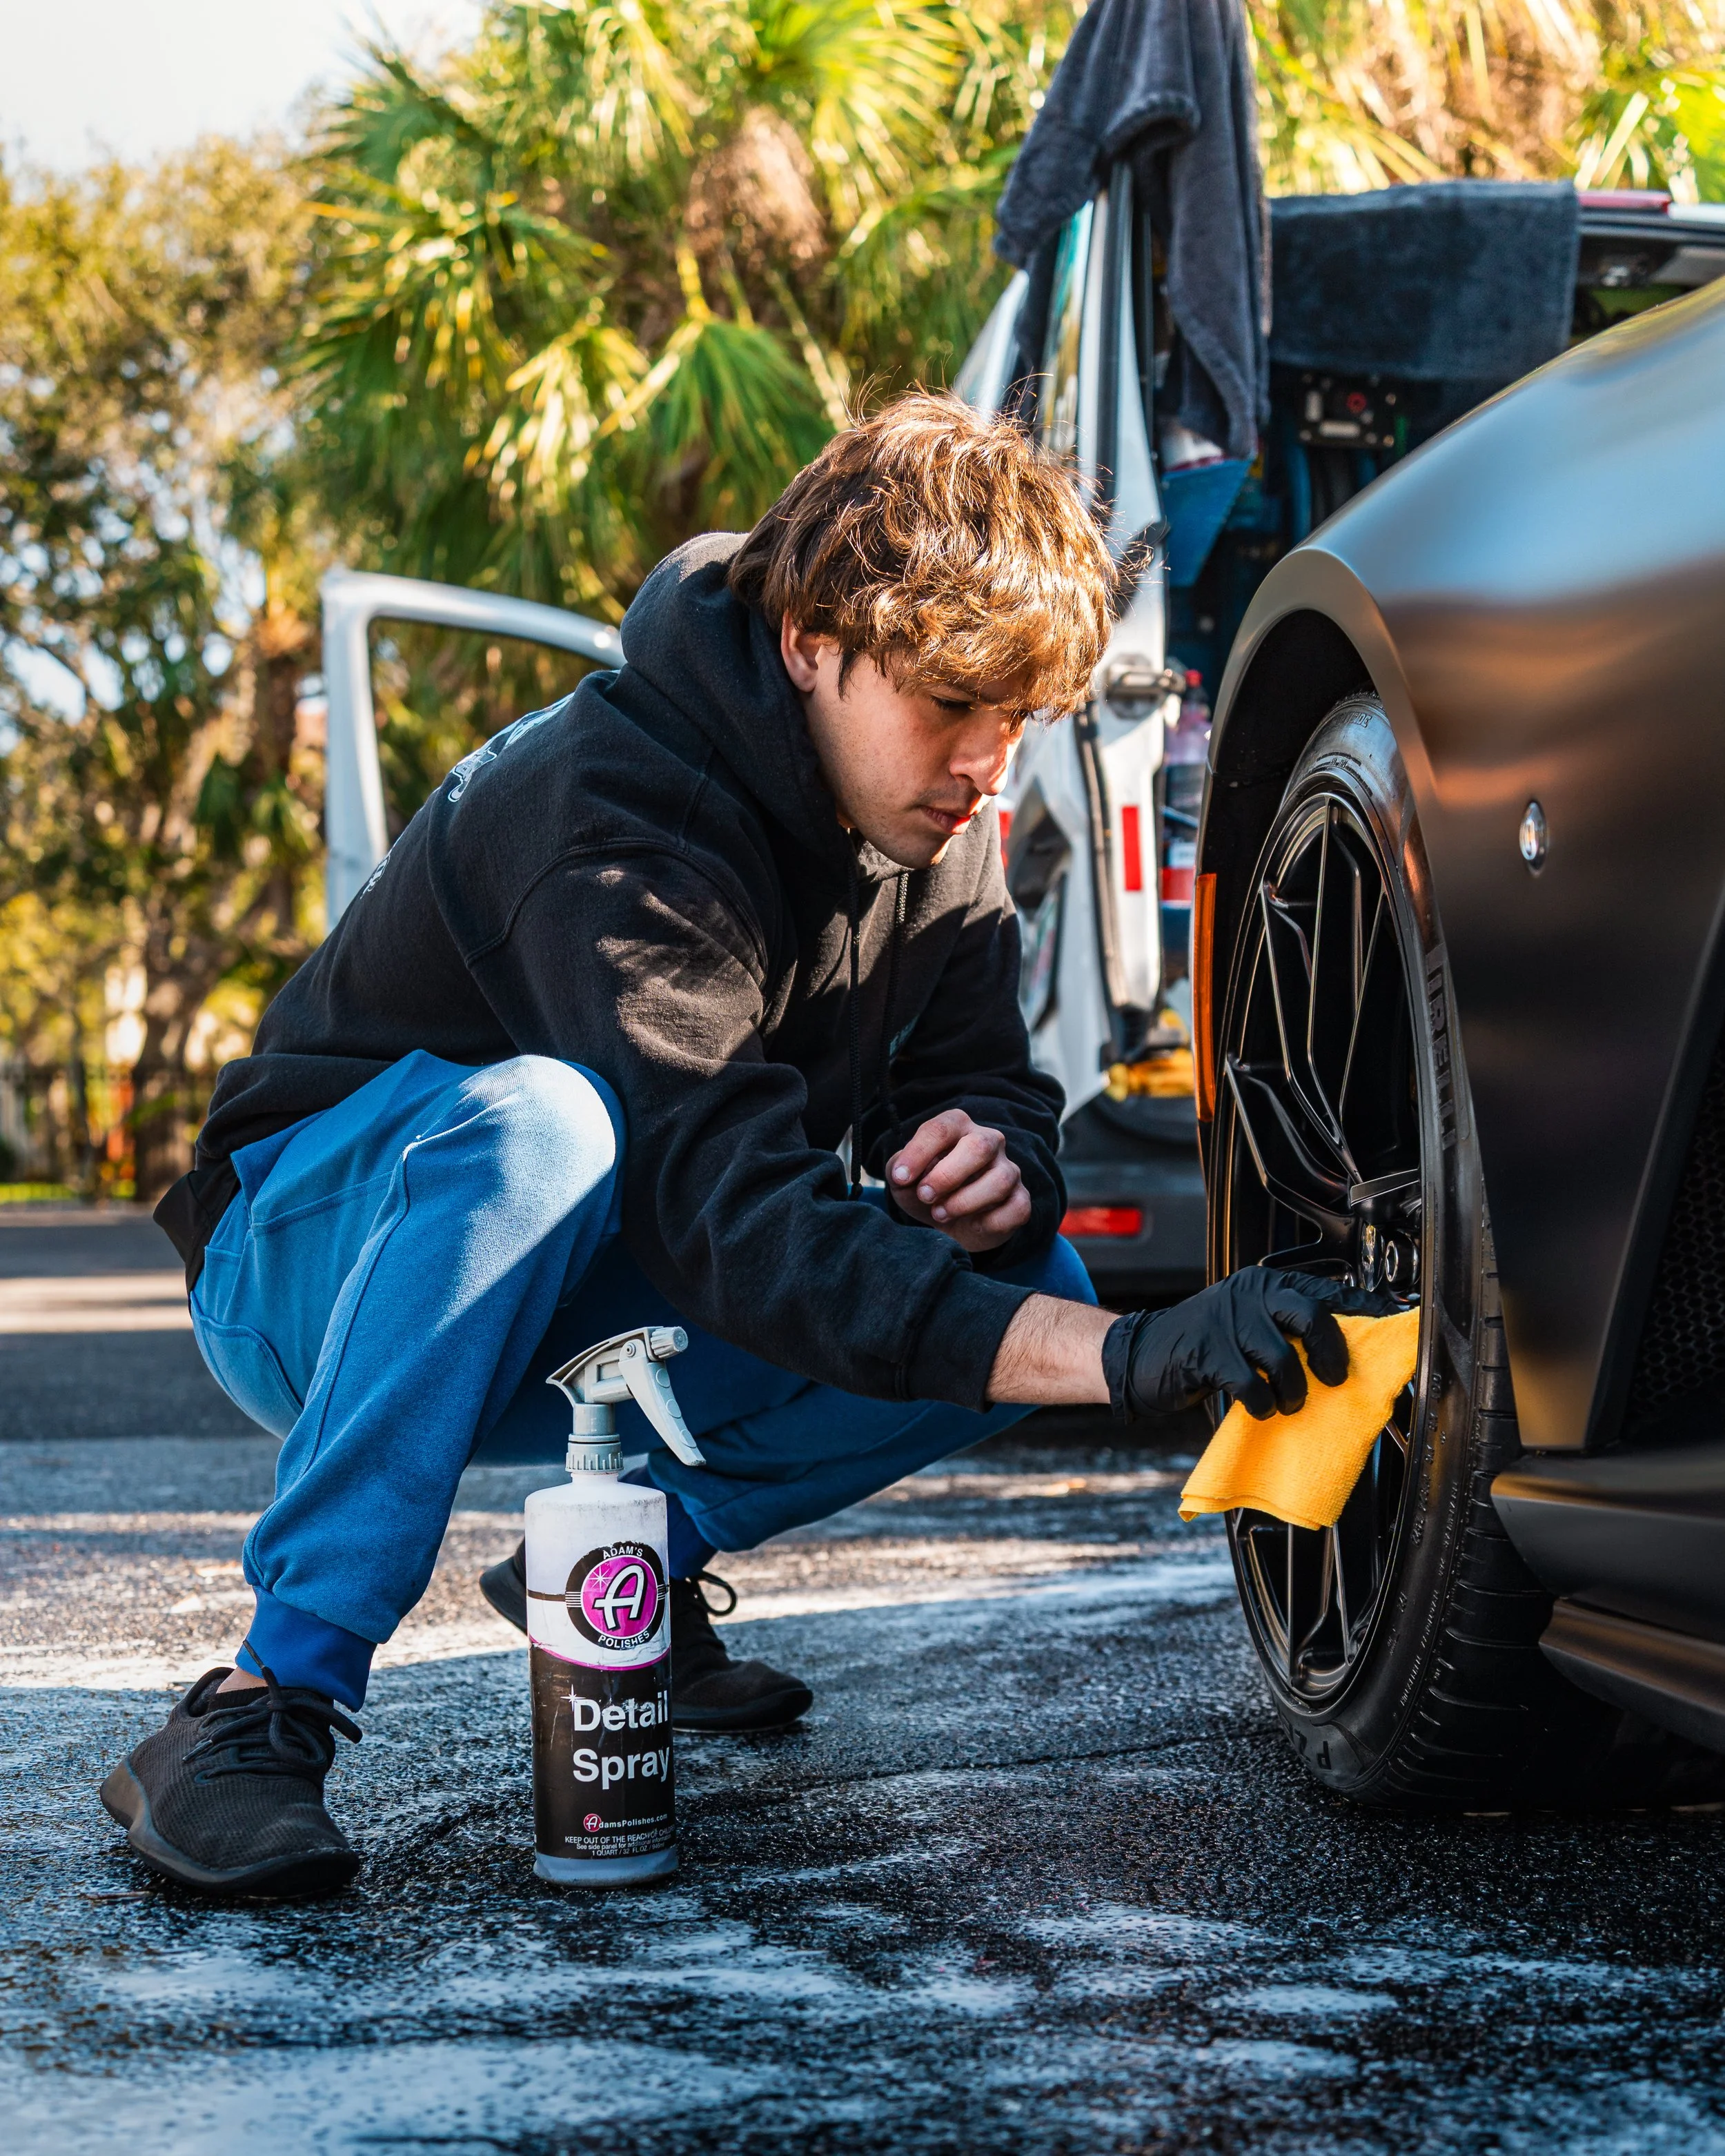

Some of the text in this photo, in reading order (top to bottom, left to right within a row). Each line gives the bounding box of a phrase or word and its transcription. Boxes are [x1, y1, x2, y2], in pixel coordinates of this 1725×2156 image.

[602, 1545, 644, 1560] ADAM'S
[598, 1630, 650, 1649] POLISHES
[573, 1690, 668, 1732] Detail
[573, 1747, 670, 1790] Spray
[602, 1843, 618, 1851] panel
